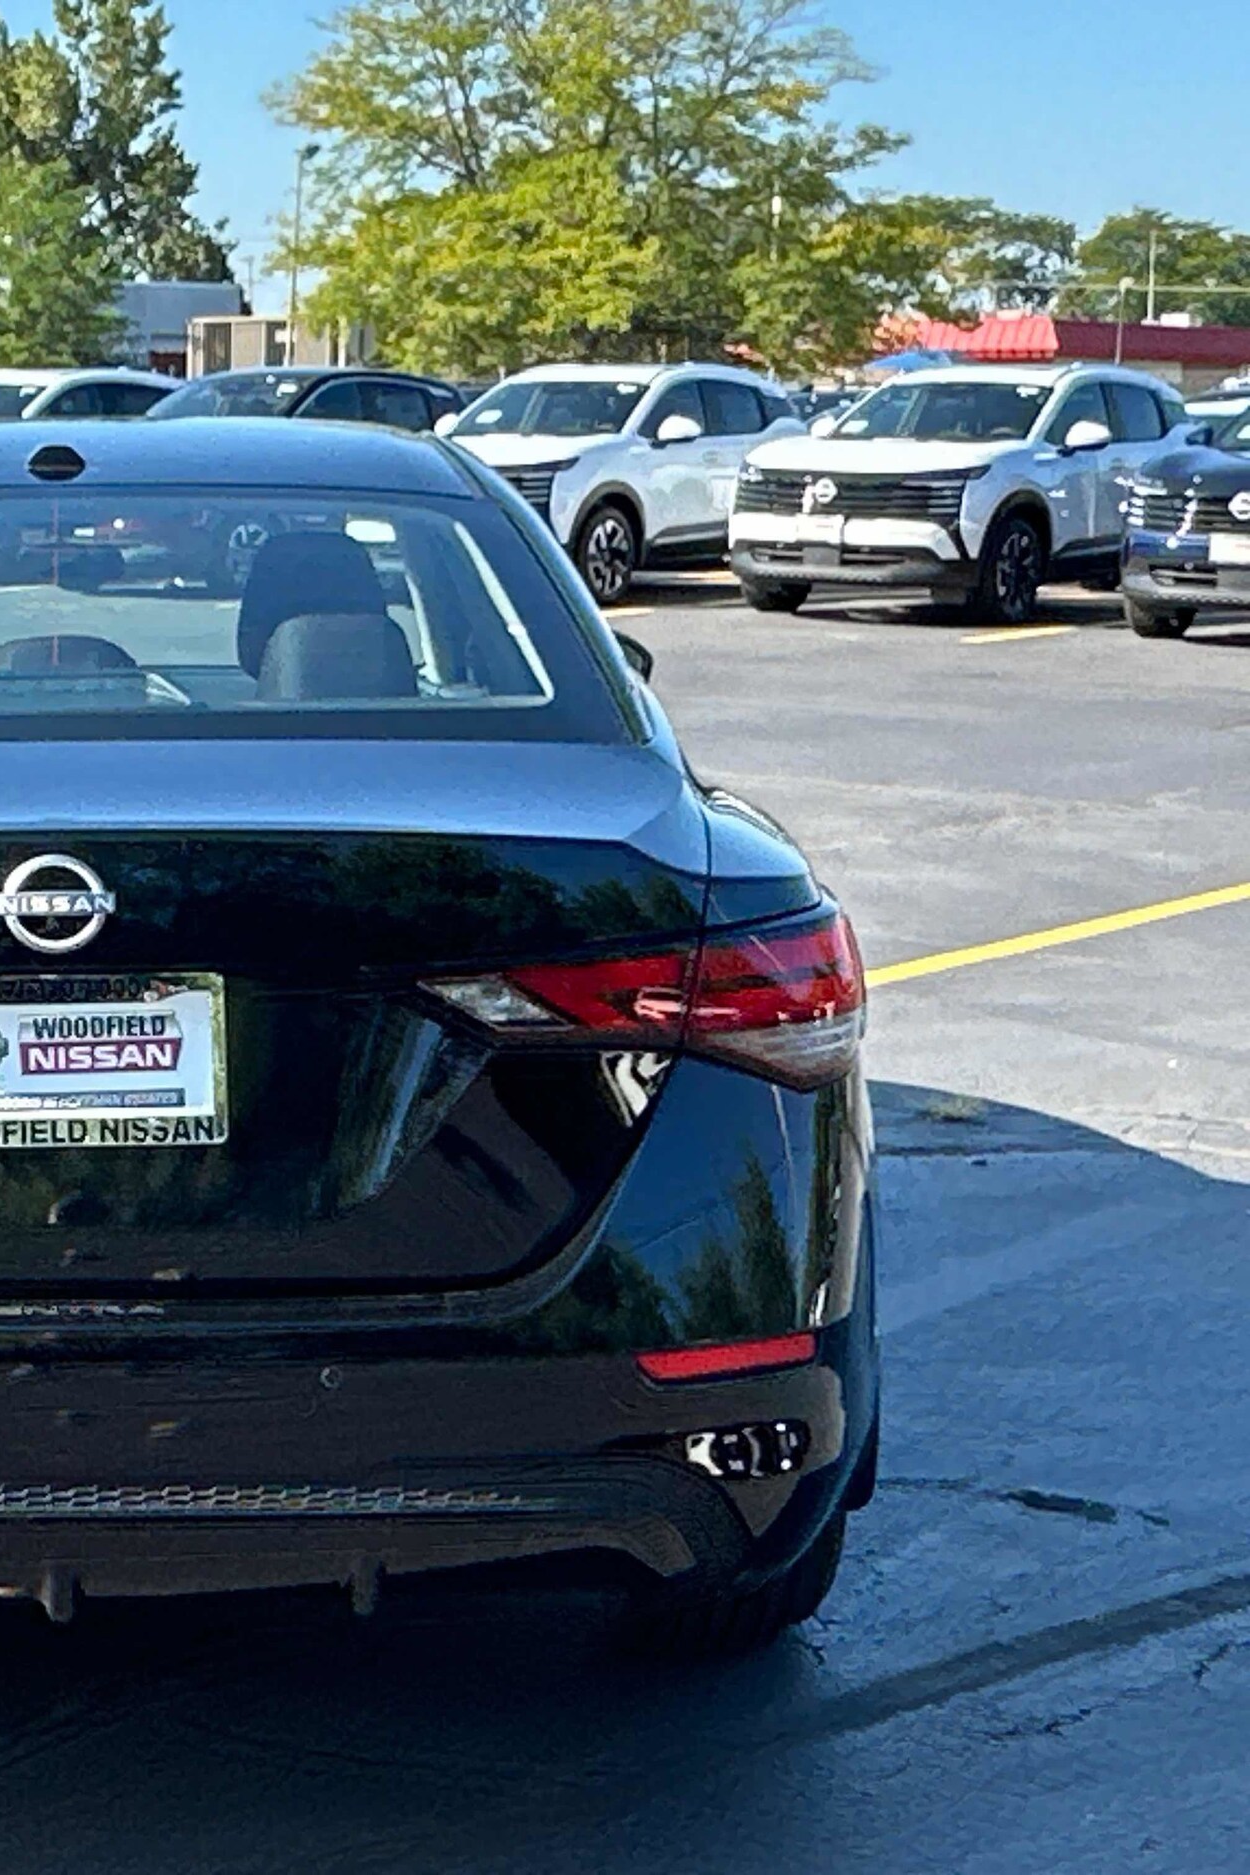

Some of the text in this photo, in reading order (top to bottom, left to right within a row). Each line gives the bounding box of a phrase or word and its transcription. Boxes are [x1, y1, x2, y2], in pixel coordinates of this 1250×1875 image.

[32, 1015, 166, 1039] WOODFIELD
[28, 1043, 173, 1071] NISSAN
[100, 1116, 216, 1143] NISSAN
